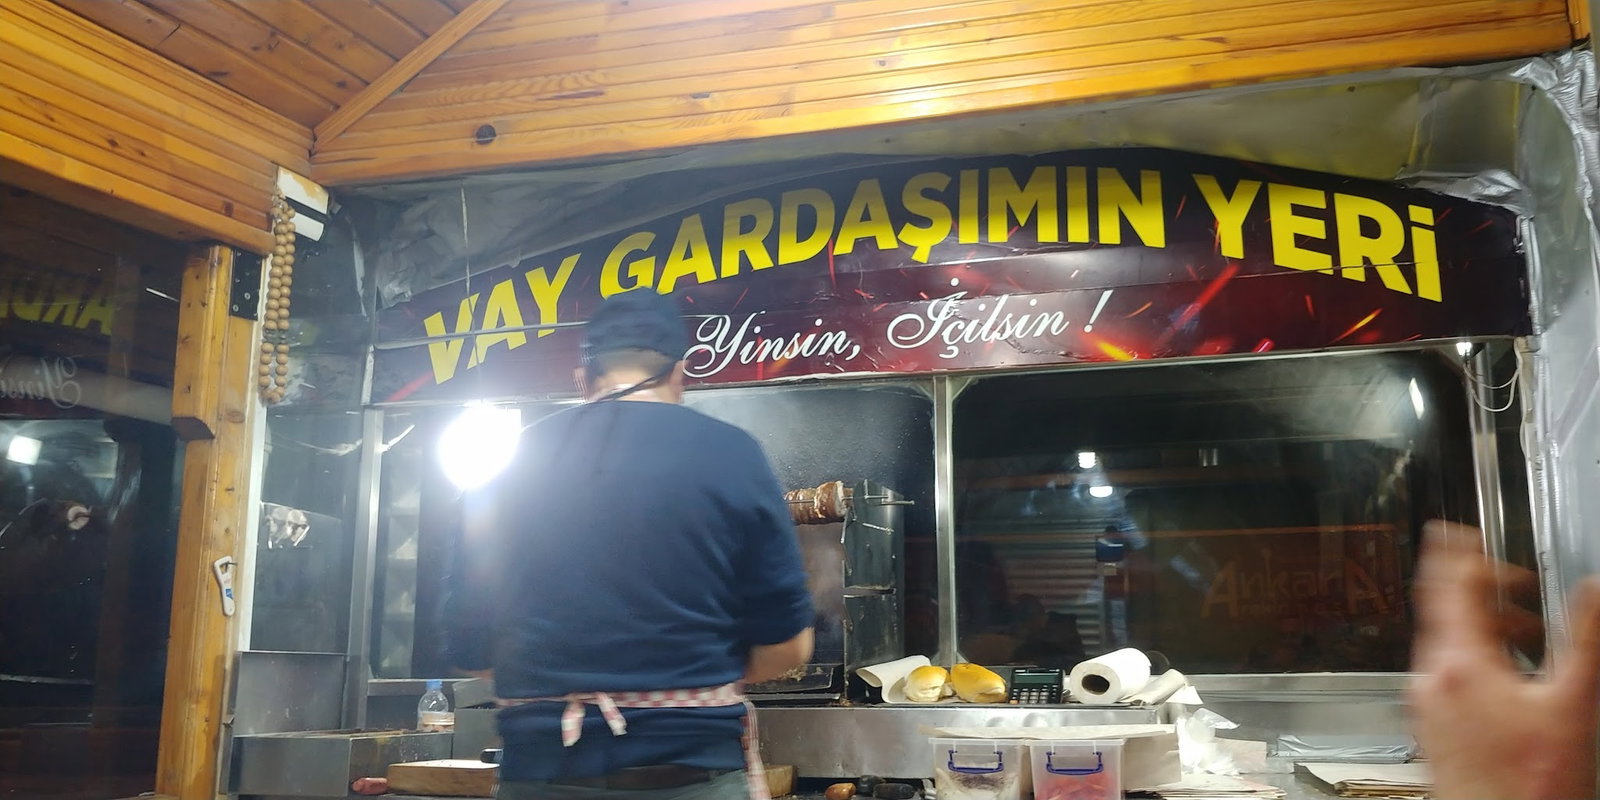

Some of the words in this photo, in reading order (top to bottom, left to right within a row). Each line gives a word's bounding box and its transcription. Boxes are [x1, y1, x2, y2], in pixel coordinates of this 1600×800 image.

[423, 253, 580, 385] VAY
[600, 166, 1166, 300] GARDAŞIMIN
[1193, 174, 1442, 303] YERİ
[682, 310, 861, 378] Yinsin,
[887, 277, 1069, 359] İçilsin
